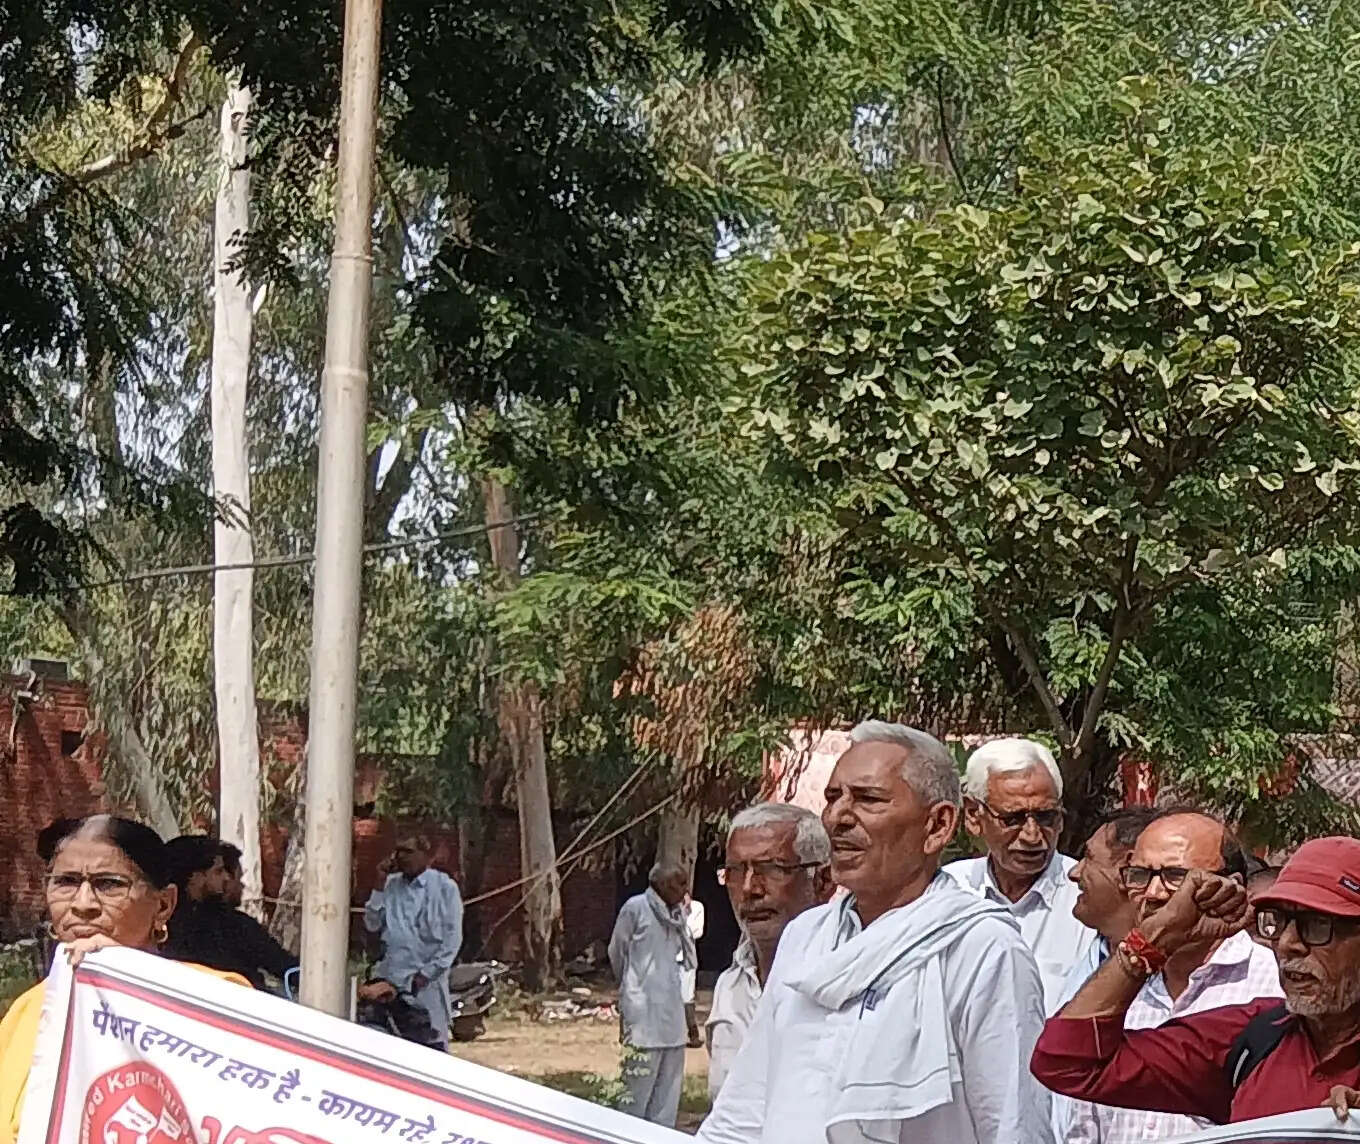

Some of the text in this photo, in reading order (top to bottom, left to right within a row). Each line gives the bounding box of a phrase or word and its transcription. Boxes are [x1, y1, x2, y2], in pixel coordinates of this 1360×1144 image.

[140, 1025, 224, 1067] हमारा
[218, 1058, 276, 1089] हक
[273, 1069, 301, 1104] है
[318, 1089, 401, 1133] कायम
